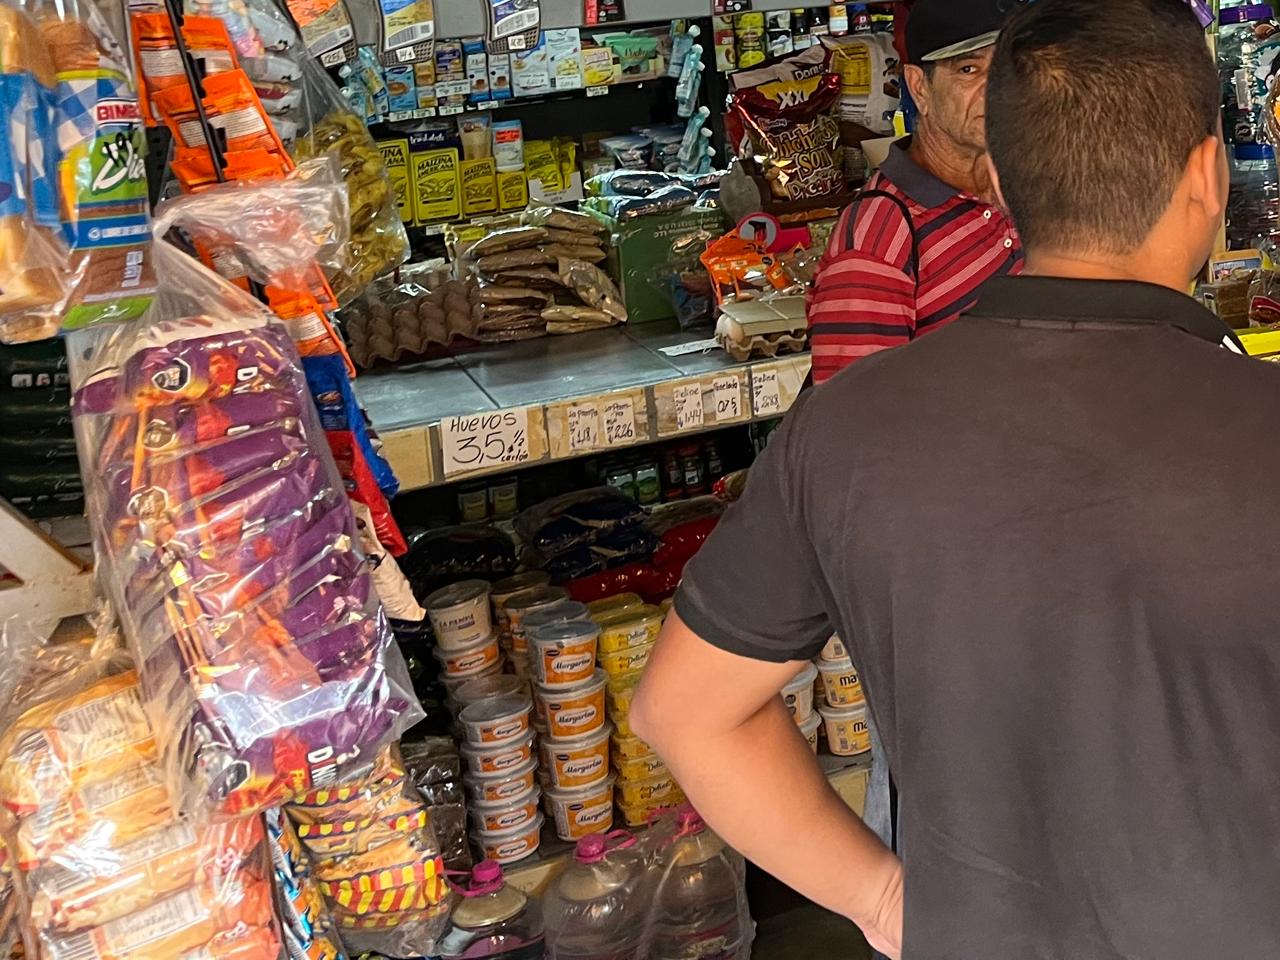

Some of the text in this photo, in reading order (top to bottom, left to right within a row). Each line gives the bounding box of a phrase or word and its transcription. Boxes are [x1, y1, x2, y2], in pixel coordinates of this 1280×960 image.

[417, 158, 454, 171] MAIZINA
[417, 166, 454, 179] AMERICANA
[458, 656, 485, 668] Margarina
[553, 657, 592, 671] Margarina
[557, 710, 596, 724] Margarina
[496, 724, 522, 736] Margarina
[496, 753, 523, 766] Margarina
[565, 759, 603, 774] Margarina
[500, 812, 527, 825] Margarina
[577, 806, 614, 823] Margarina
[499, 841, 527, 855] Margarina
